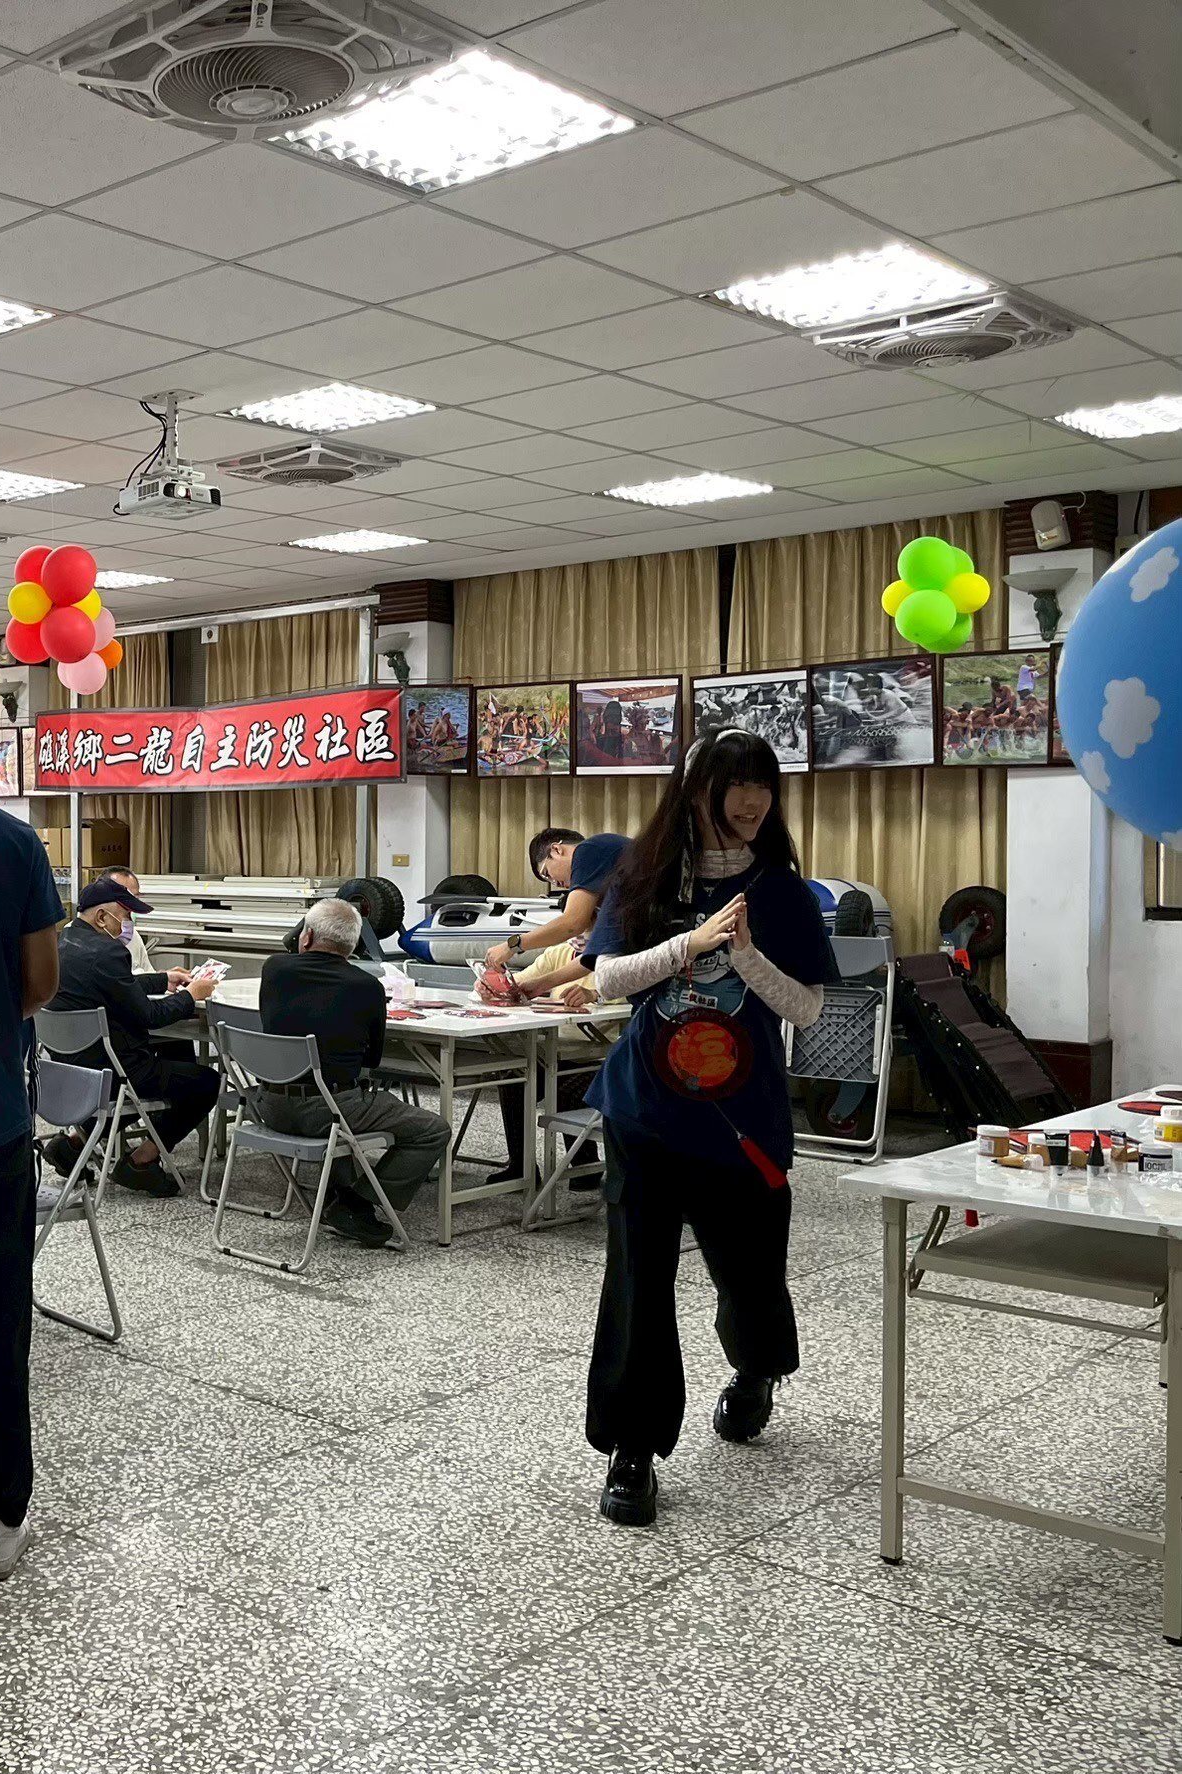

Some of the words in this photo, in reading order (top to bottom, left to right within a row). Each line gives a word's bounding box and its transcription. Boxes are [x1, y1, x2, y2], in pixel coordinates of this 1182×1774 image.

[39, 709, 398, 775] 礁溪鄉二龍自主防災社區
